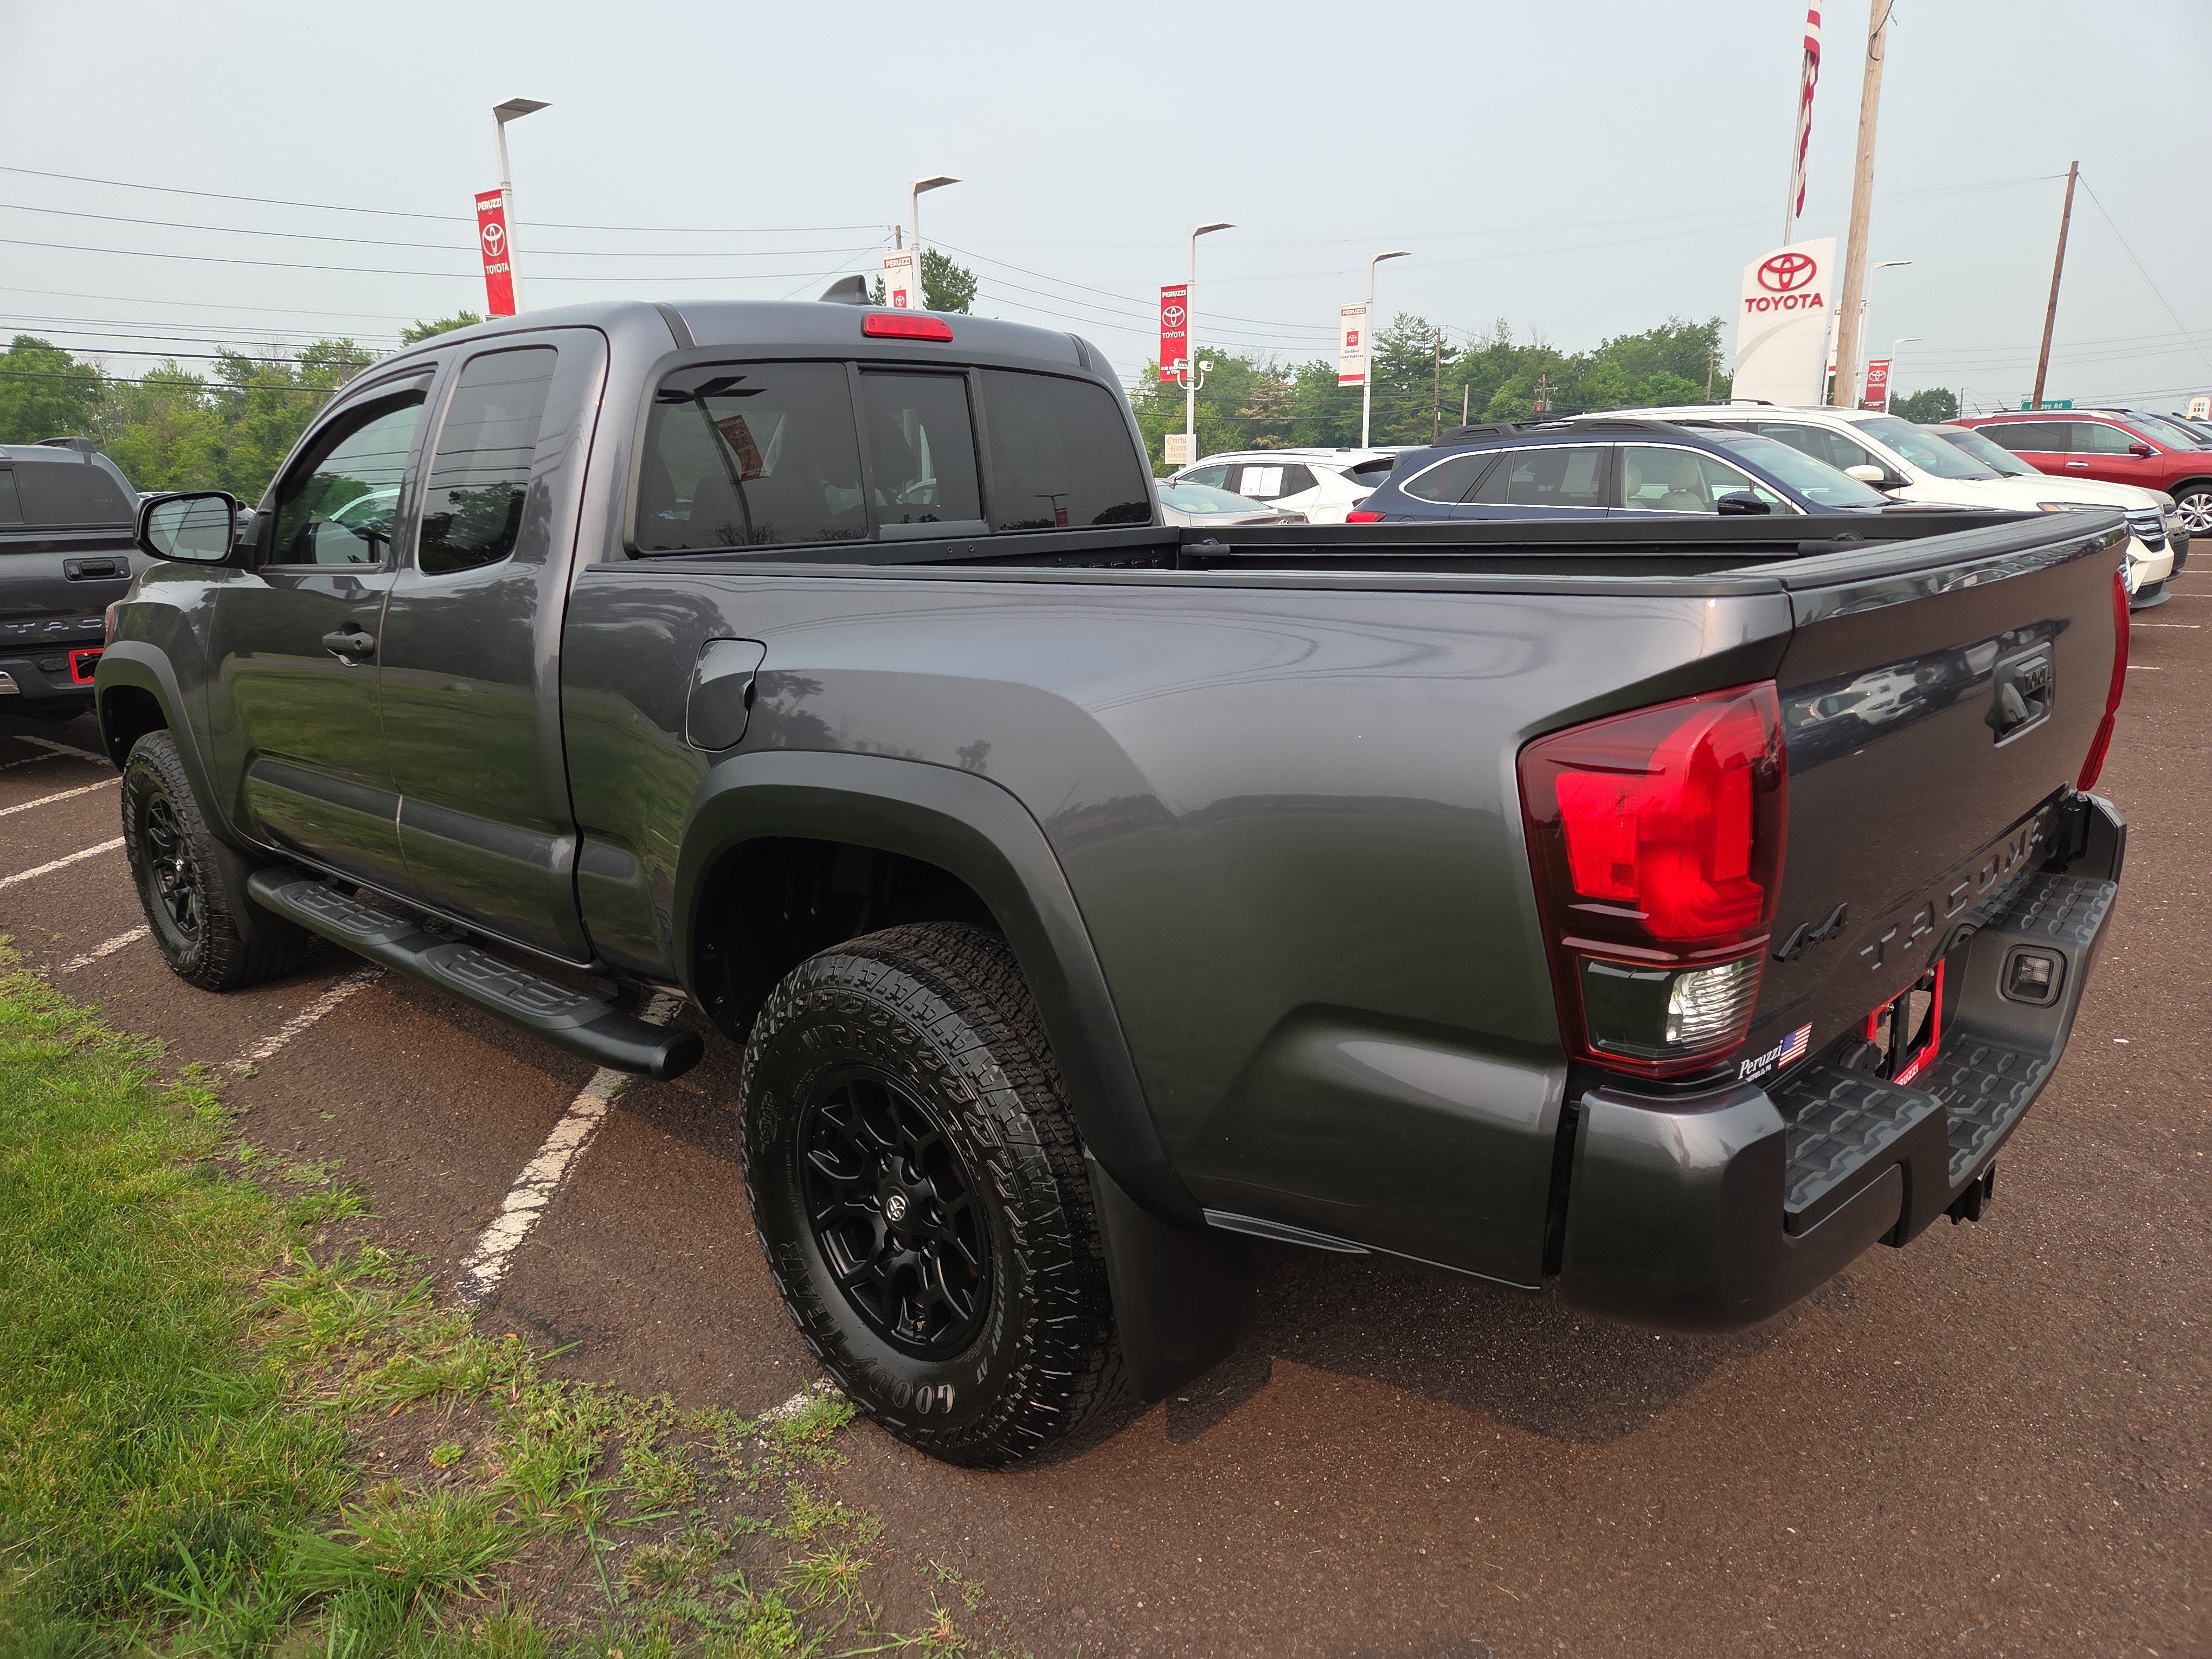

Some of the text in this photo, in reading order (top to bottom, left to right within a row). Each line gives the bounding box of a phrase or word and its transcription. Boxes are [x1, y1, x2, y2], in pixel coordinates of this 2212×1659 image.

[478, 197, 502, 212] PERUZZI
[485, 262, 510, 275] TOYOTA
[885, 258, 911, 268] PERUZZI
[1162, 290, 1186, 298] PERUZZI
[1745, 293, 1824, 313] TOYOTA
[1342, 308, 1365, 316] PERUZZI
[1162, 331, 1185, 339] TOYOTA
[1167, 436, 1186, 445] Centu
[5, 619, 102, 633] TAC
[1860, 806, 2046, 970] TACOMA
[1738, 1039, 1784, 1080] Peruzzi
[1896, 1062, 1919, 1086] RUZZI
[777, 1240, 956, 1415] GOODYEAR
